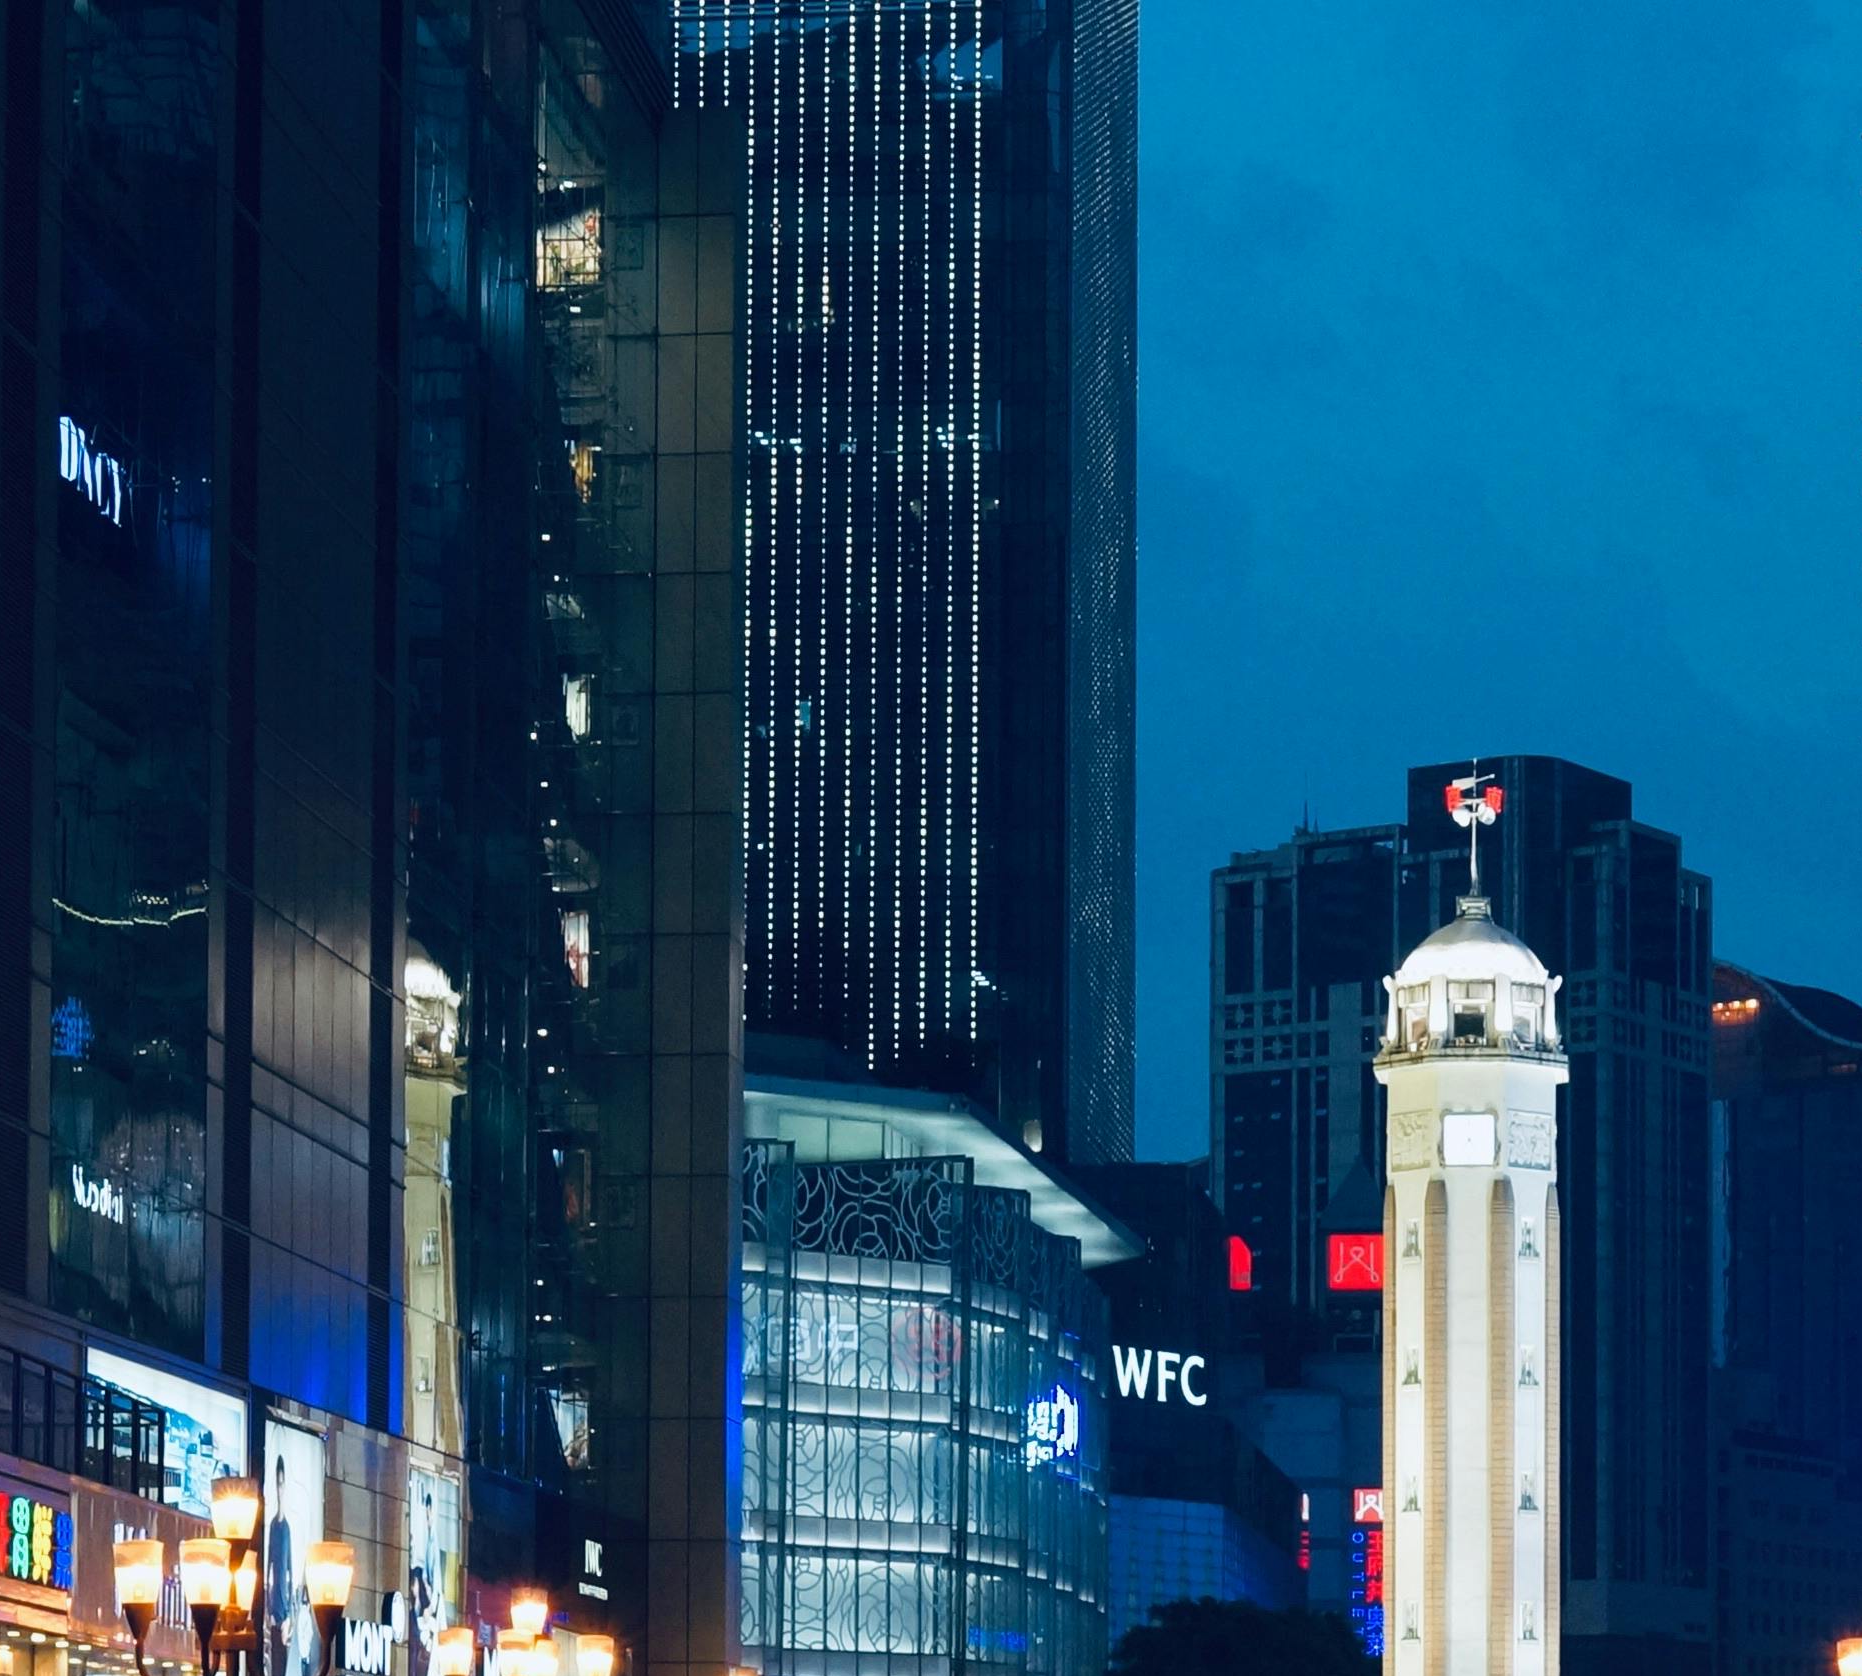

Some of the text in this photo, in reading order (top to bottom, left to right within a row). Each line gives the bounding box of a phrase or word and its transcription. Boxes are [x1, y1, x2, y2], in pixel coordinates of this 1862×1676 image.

[1112, 1345, 1207, 1406] WFC
[585, 1539, 603, 1577] IWC
[344, 1618, 393, 1676] MONT
